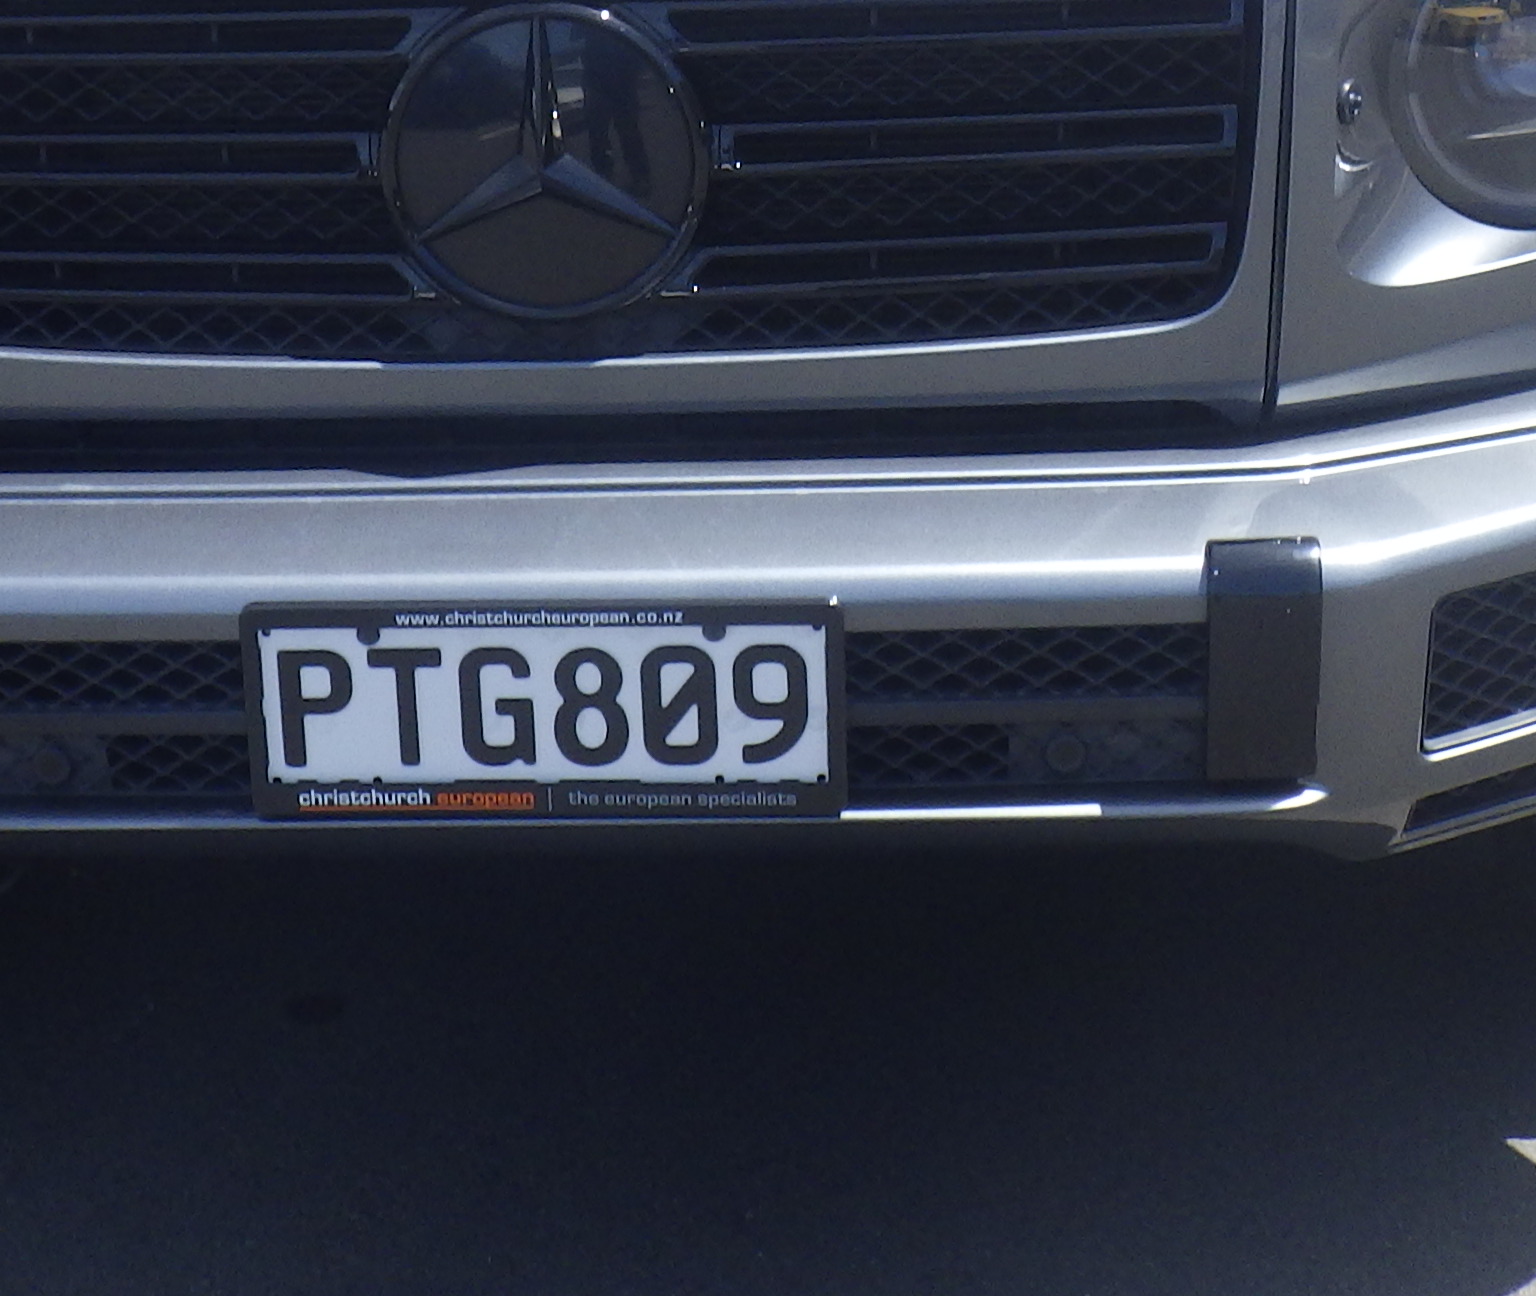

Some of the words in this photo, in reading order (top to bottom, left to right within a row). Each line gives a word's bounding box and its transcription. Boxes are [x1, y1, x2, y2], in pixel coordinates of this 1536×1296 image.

[394, 609, 683, 627] www.christchurcheuropean.co.nz
[276, 644, 810, 768] PTG809
[298, 788, 431, 807] christchurch
[436, 791, 535, 809] european
[569, 790, 599, 806] the
[603, 791, 692, 810] european
[697, 790, 798, 810] specialists
